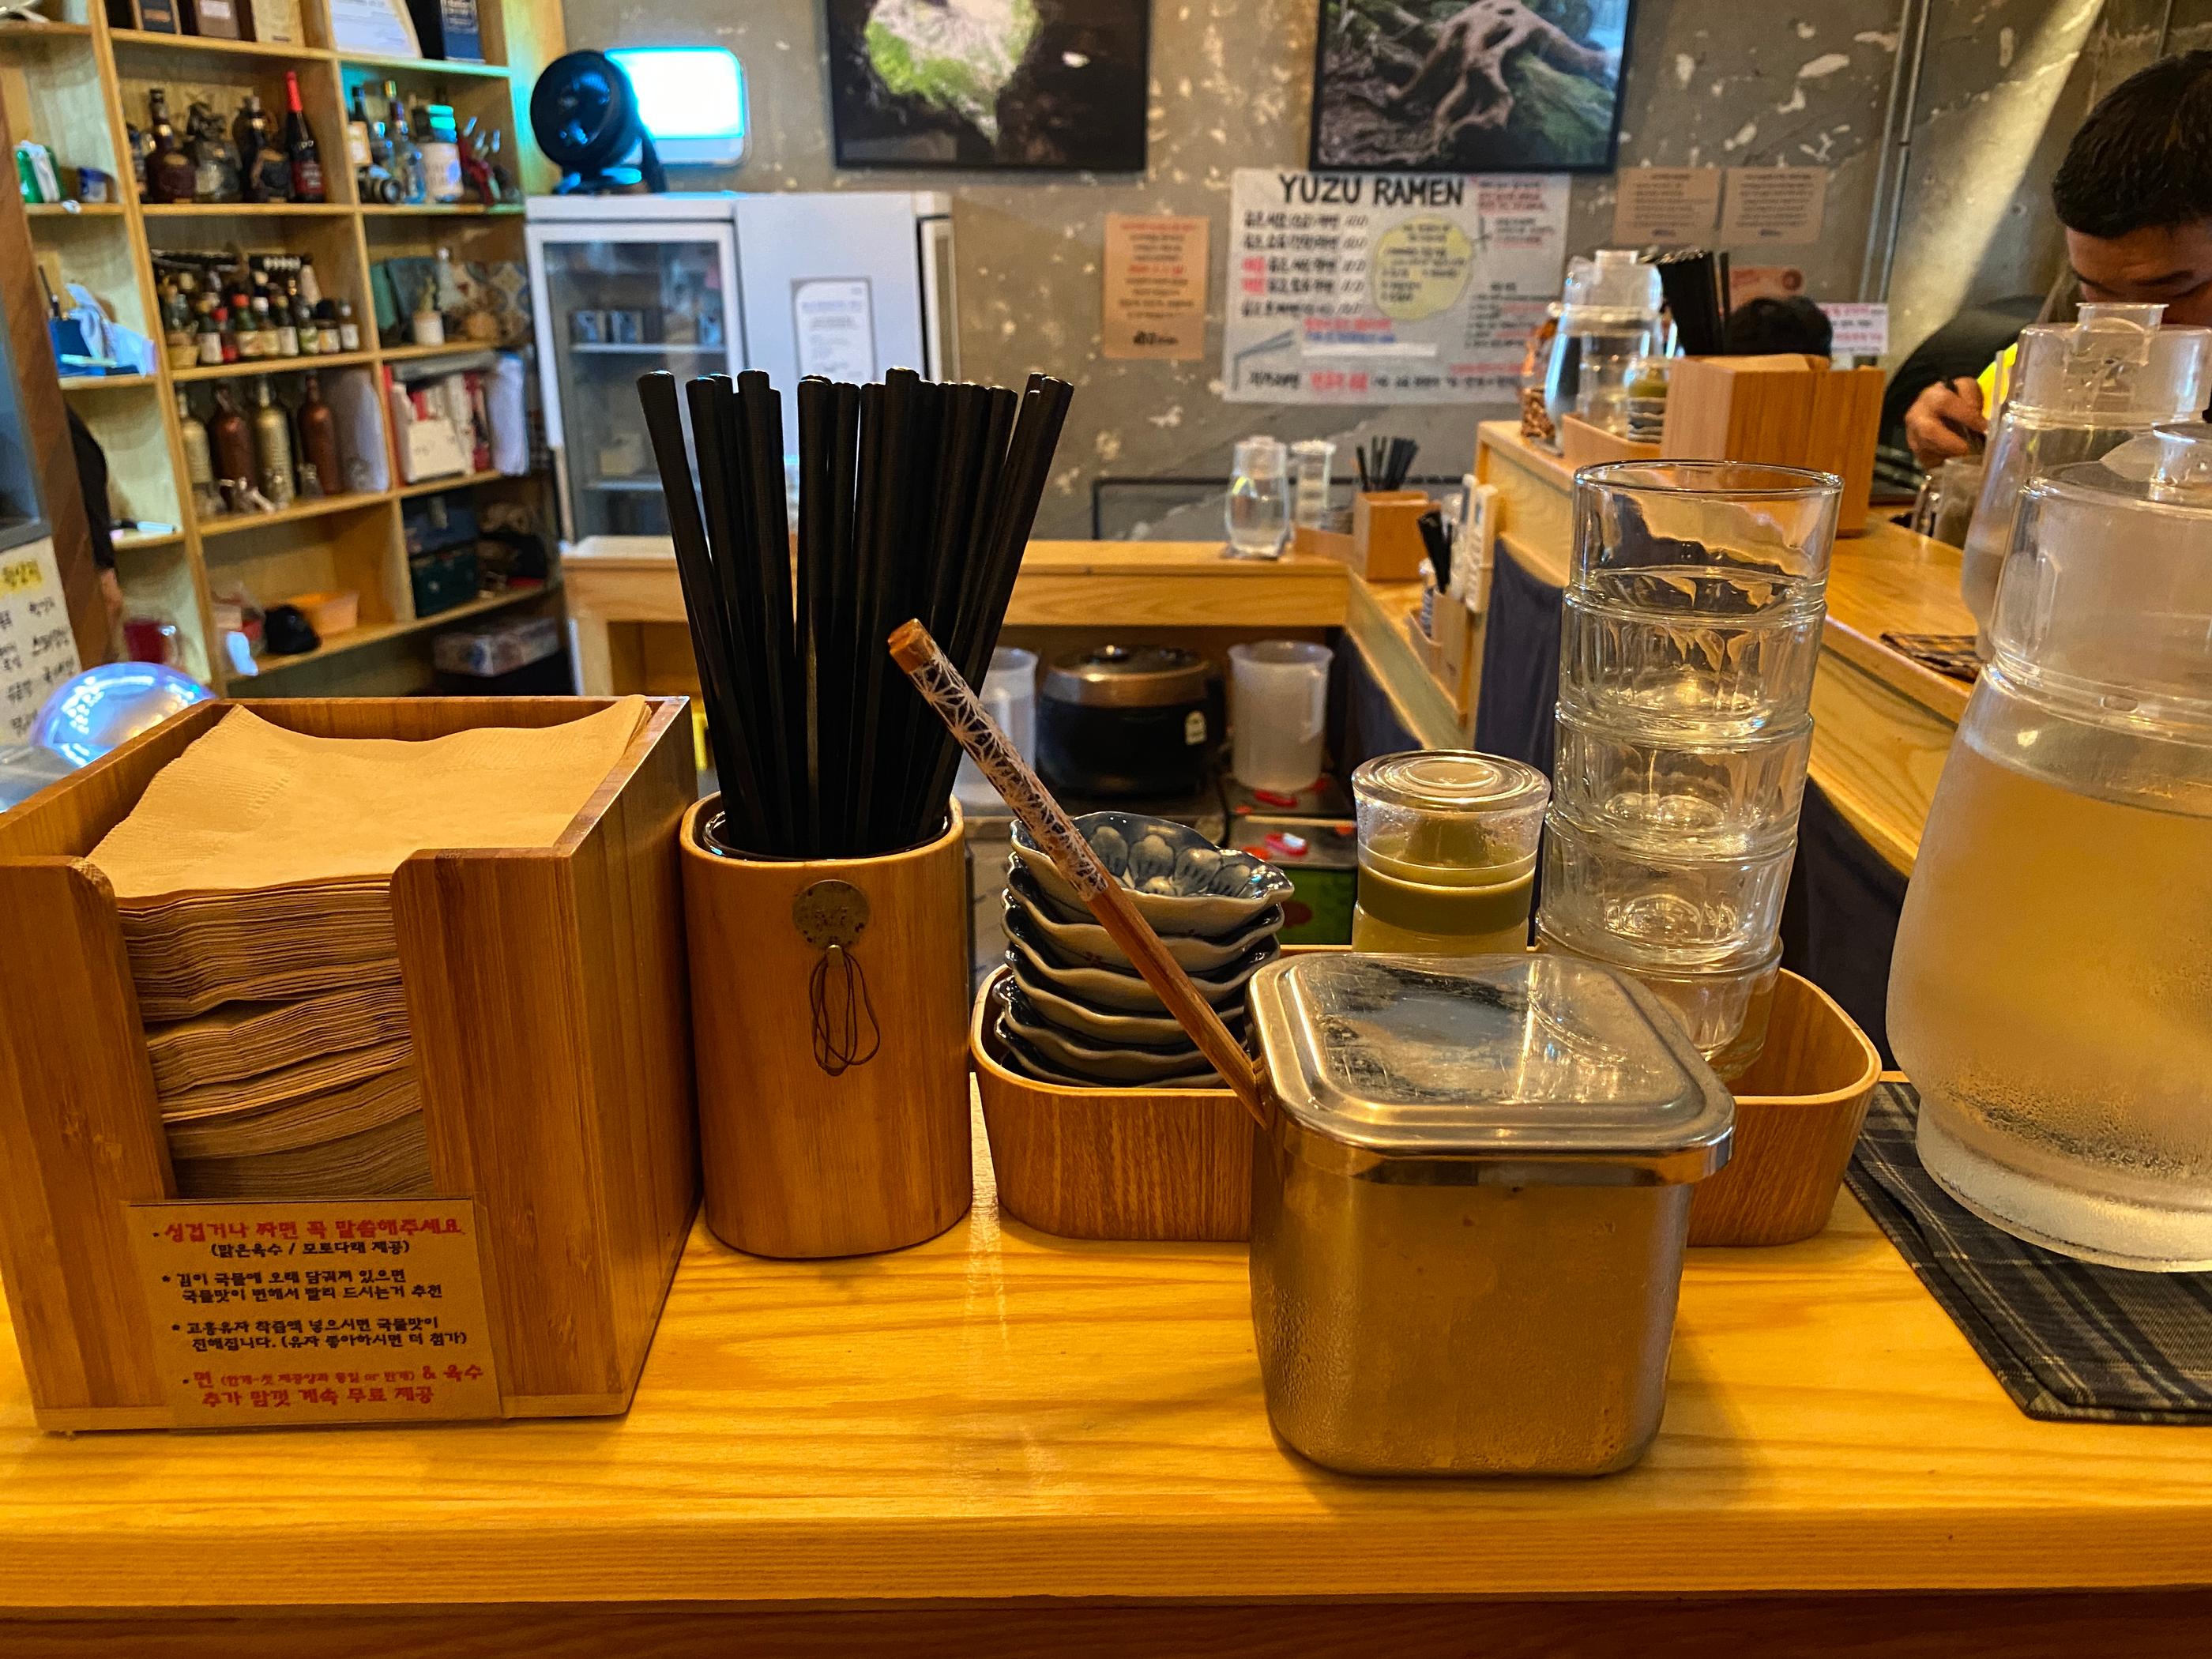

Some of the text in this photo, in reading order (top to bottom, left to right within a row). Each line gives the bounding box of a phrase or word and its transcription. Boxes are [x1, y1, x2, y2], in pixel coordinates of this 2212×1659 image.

[1279, 175, 1361, 204] YUZU
[1374, 177, 1463, 206] RAMEN
[307, 1220, 328, 1240] 꼭
[371, 1240, 410, 1255] 제공)
[176, 1273, 209, 1288] 김이
[214, 1271, 262, 1287] 국물에
[268, 1270, 300, 1284] 오래
[359, 1269, 407, 1284] 있으면
[182, 1288, 246, 1304] 국물맛이
[304, 1286, 336, 1302] 빨리
[343, 1285, 405, 1300] 드시는거
[411, 1284, 442, 1299] 추천
[308, 1318, 372, 1334] 넣으시면
[376, 1316, 438, 1332] 국물맛이
[280, 1335, 319, 1349] (유자
[325, 1333, 403, 1349] 좋아하시면
[408, 1333, 423, 1345] 더
[193, 1371, 214, 1389] 면
[422, 1365, 437, 1380] &
[442, 1364, 483, 1382] 육수
[201, 1390, 243, 1408] 추가
[297, 1387, 339, 1406] 계속
[347, 1387, 388, 1404] 무료
[394, 1386, 434, 1405] 제공
